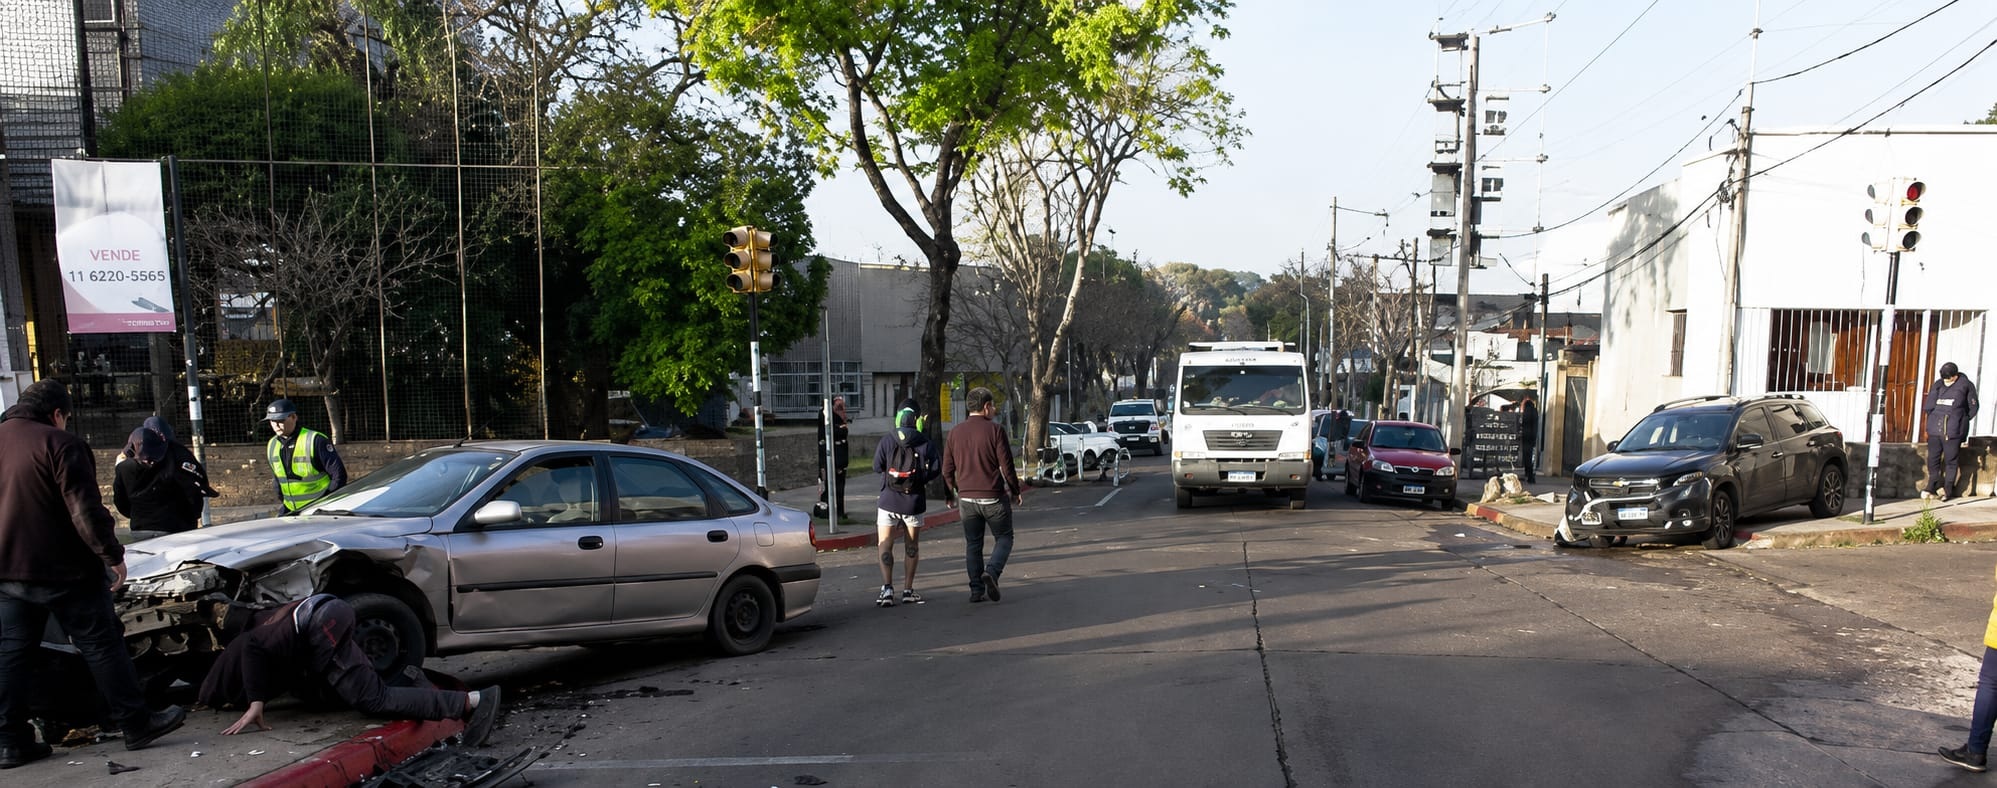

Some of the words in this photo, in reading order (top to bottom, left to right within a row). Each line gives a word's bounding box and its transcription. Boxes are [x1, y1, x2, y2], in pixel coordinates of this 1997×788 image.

[89, 249, 141, 261] VENDE
[69, 270, 84, 282] 11
[89, 270, 166, 282] 6220-5565
